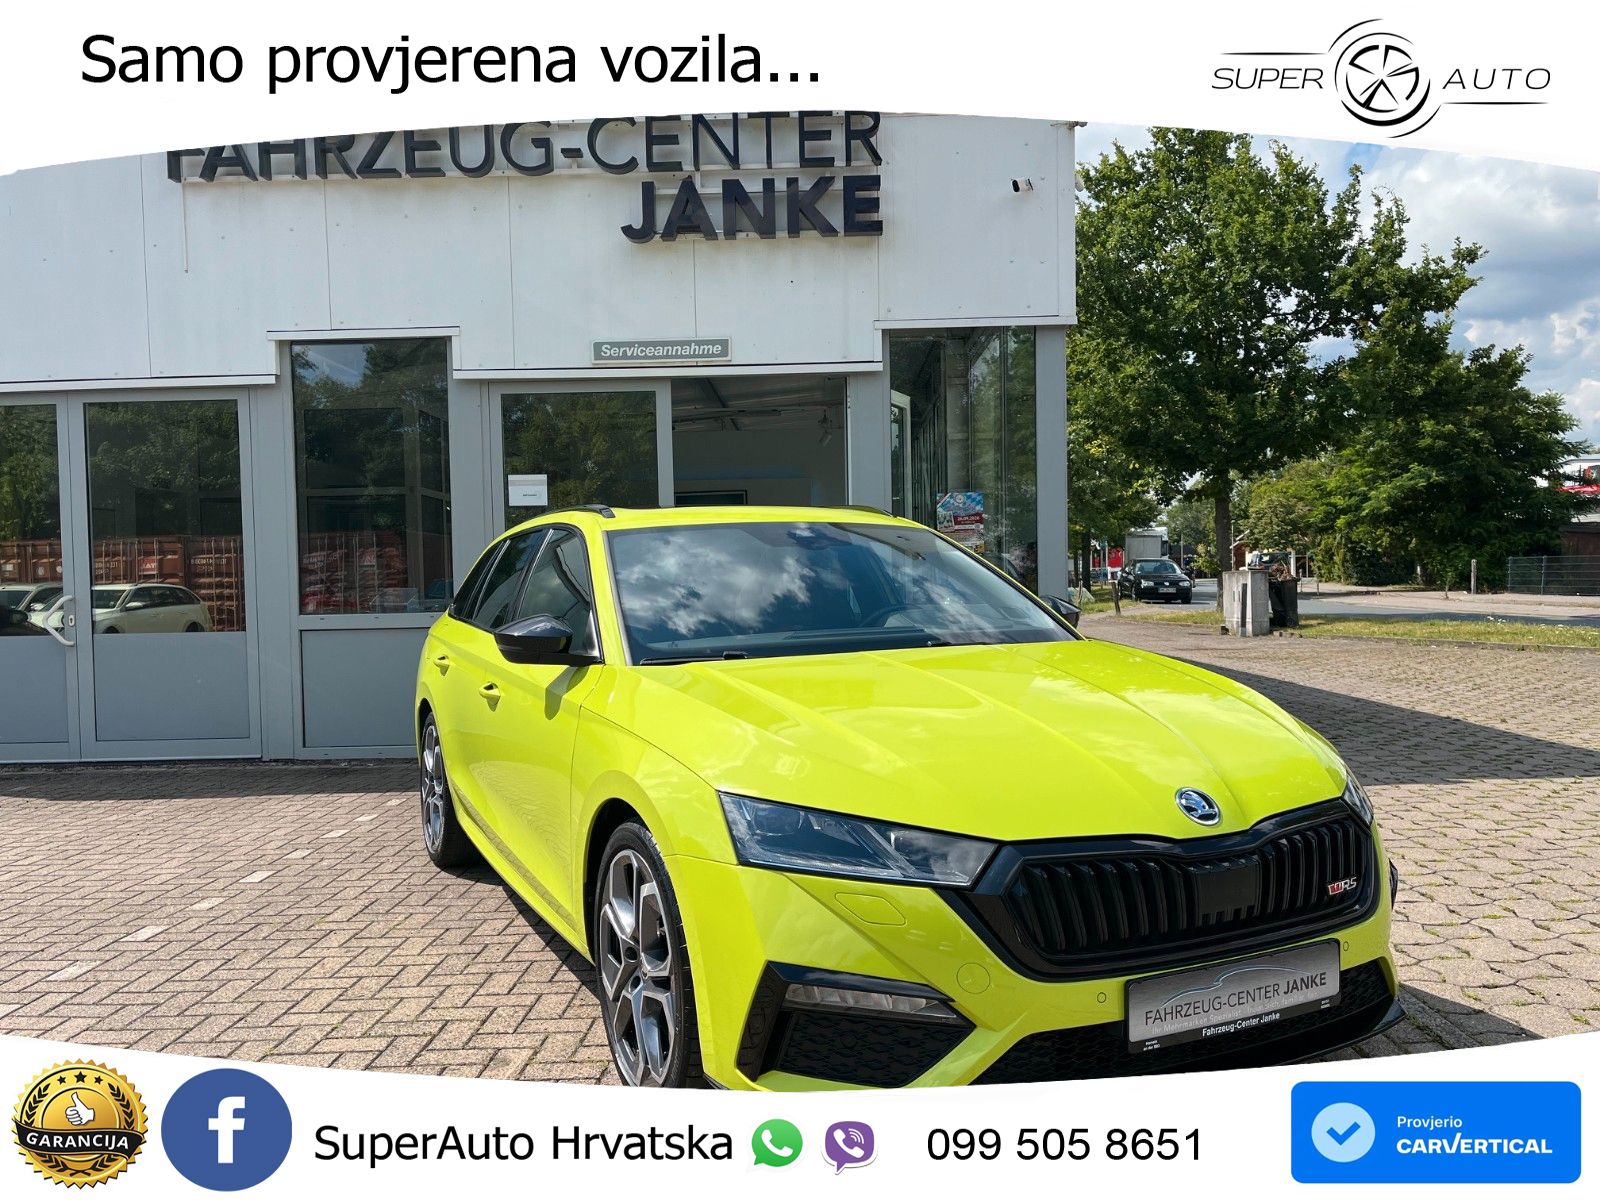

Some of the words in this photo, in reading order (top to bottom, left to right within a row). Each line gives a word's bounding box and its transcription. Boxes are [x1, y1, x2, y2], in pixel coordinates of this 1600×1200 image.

[620, 174, 883, 244] JANKE
[601, 342, 721, 357] Serviceannahme
[1145, 983, 1280, 1026] FAHRZEUG-CENTER
[1283, 971, 1327, 995] JANKE
[1202, 1017, 1260, 1038] Fahrzeug-Center
[1260, 1012, 1281, 1024] Janke
